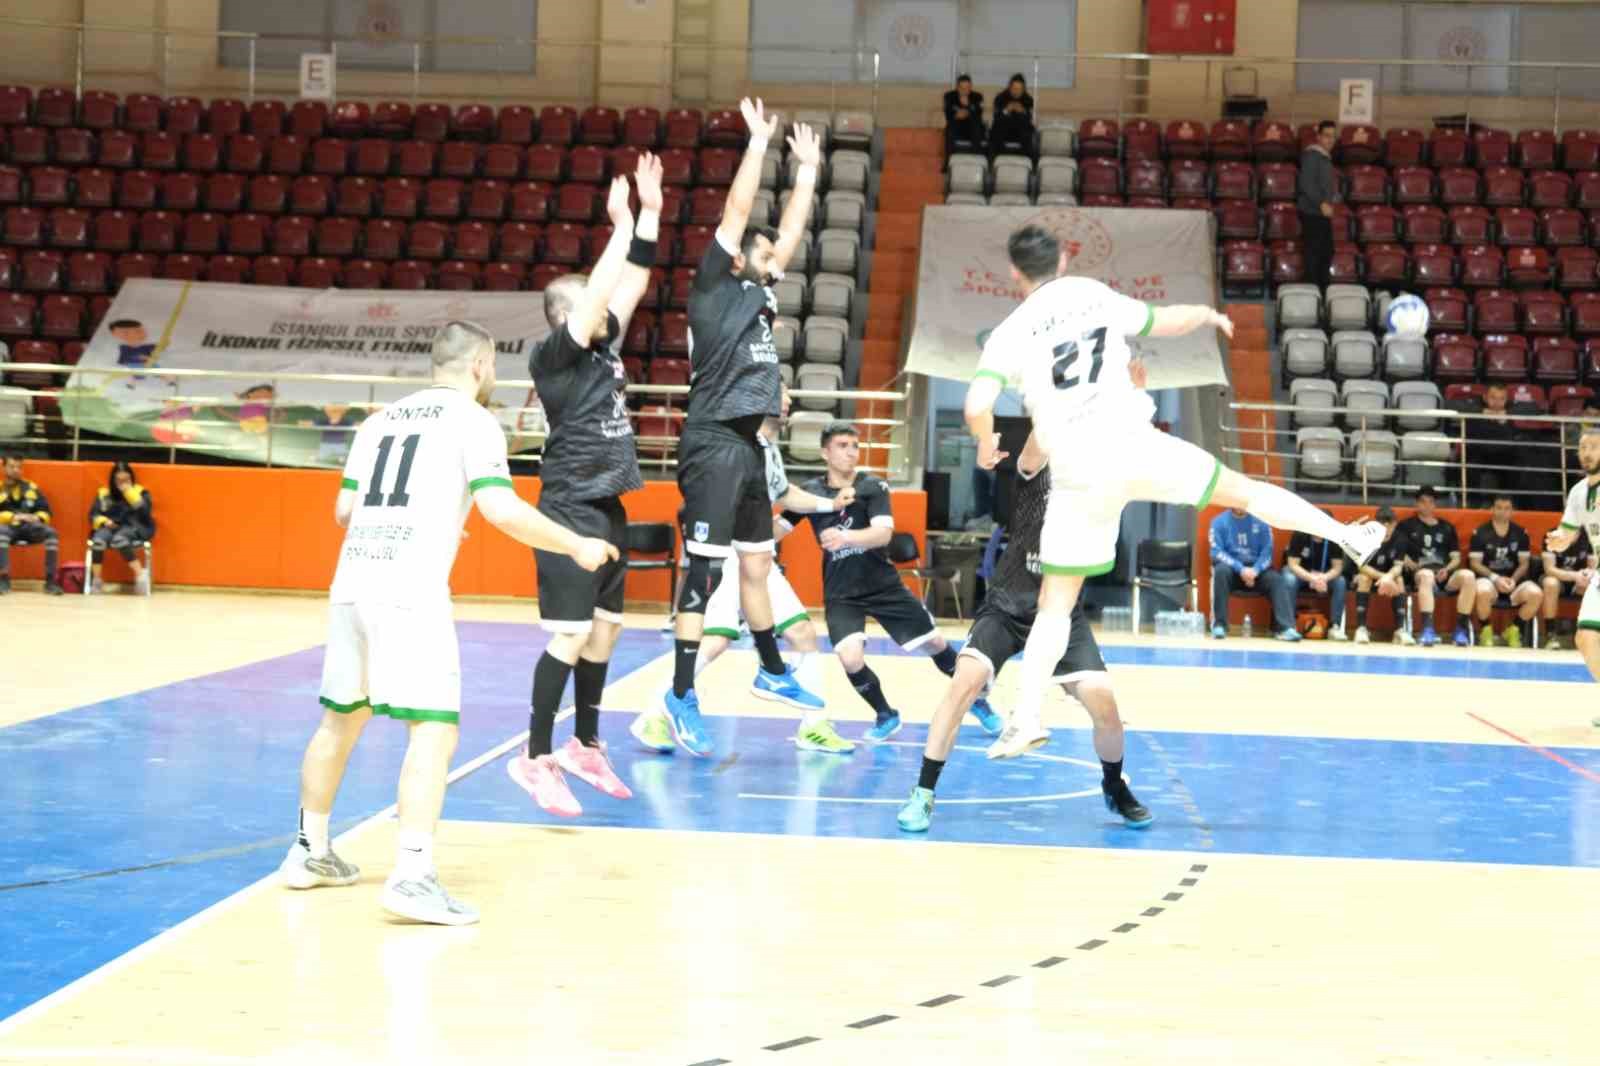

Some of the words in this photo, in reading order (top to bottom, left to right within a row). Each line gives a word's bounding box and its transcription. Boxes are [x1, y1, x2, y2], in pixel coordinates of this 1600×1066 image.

[308, 59, 324, 80] E
[1348, 84, 1364, 106] F
[201, 331, 282, 350] İLKOKUL
[286, 335, 365, 352] FİZİKSEL
[496, 338, 525, 354] ALİ
[355, 324, 397, 339] OKUL
[401, 326, 440, 340] SPO
[363, 434, 421, 507] 11
